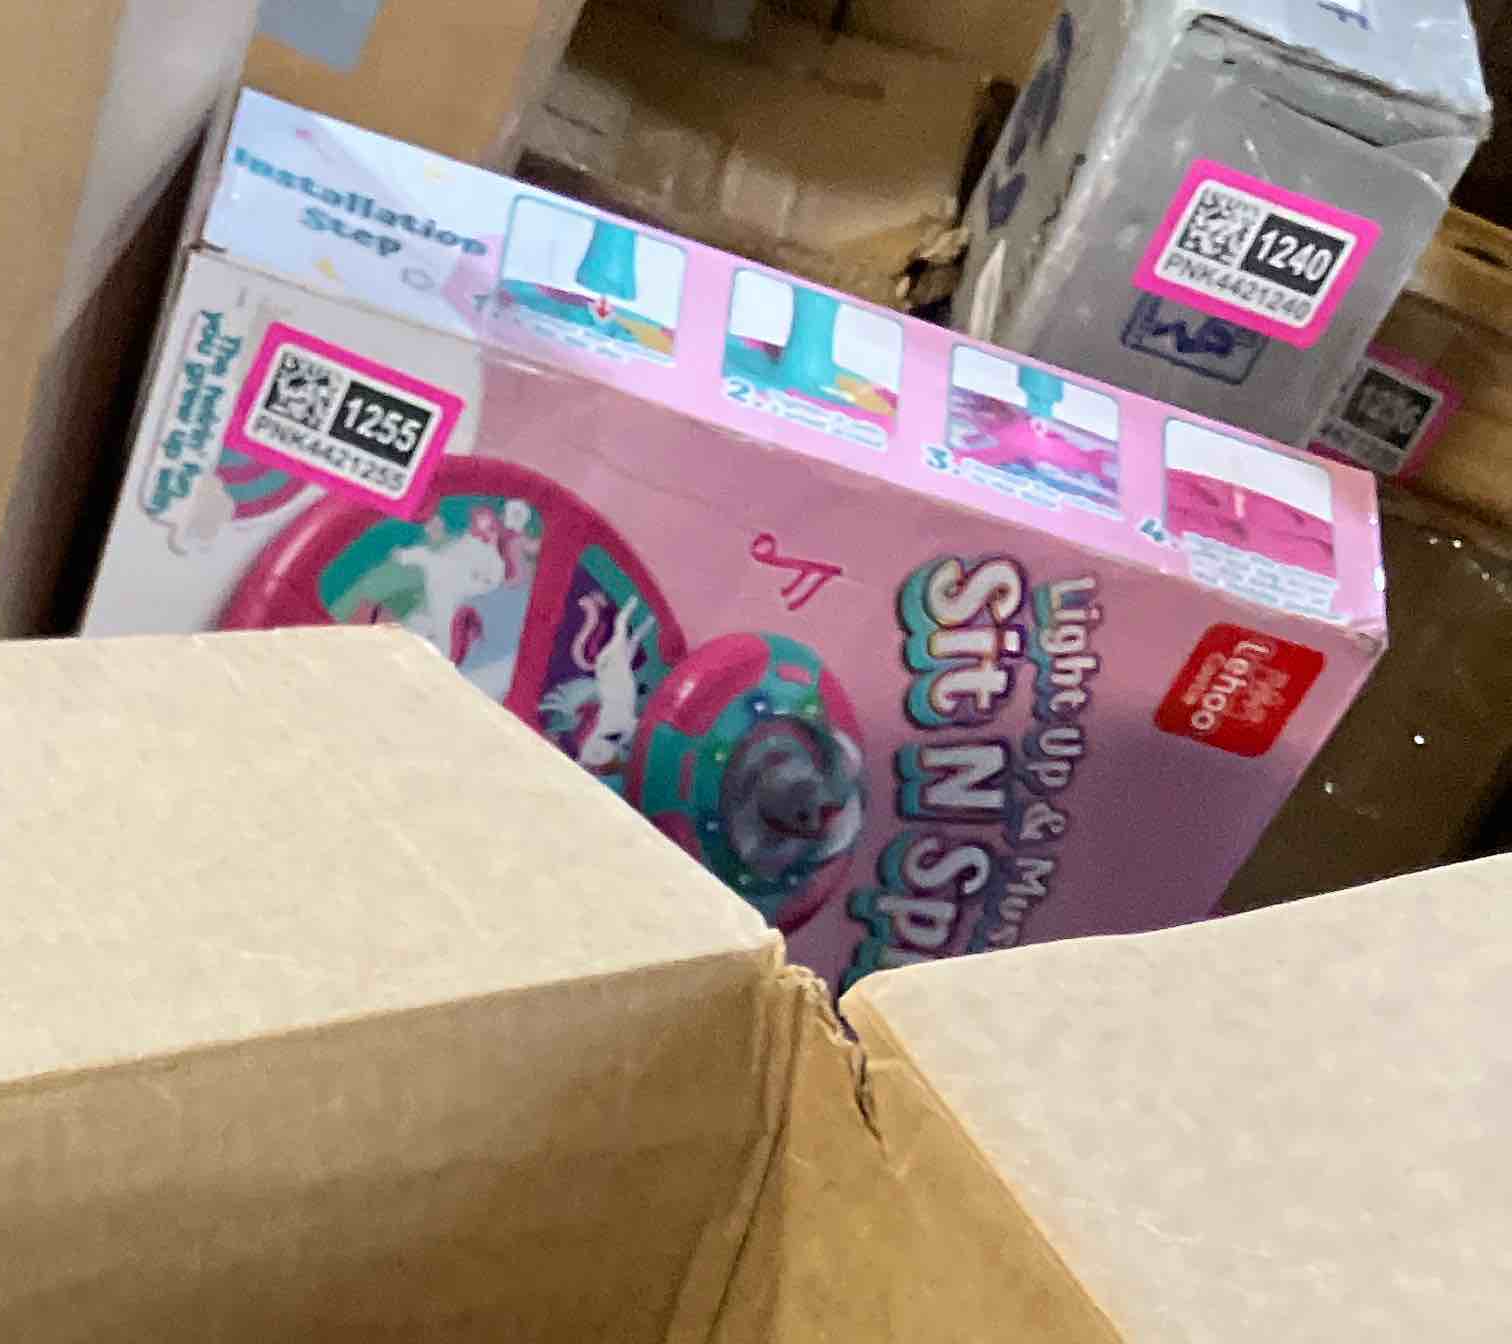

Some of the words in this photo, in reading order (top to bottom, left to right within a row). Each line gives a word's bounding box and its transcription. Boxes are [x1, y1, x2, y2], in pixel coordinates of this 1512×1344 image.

[234, 146, 488, 257] Installation
[302, 205, 403, 257] Step
[1163, 250, 1313, 321] PNK4421240
[1256, 228, 1335, 282] 1240
[343, 396, 424, 453] 1255
[918, 553, 1027, 718] Sit
[1039, 575, 1103, 713] Light
[1190, 639, 1271, 732] Lehoo
[914, 741, 1008, 812] N
[1026, 726, 1085, 789] Up
[1018, 800, 1067, 841] &
